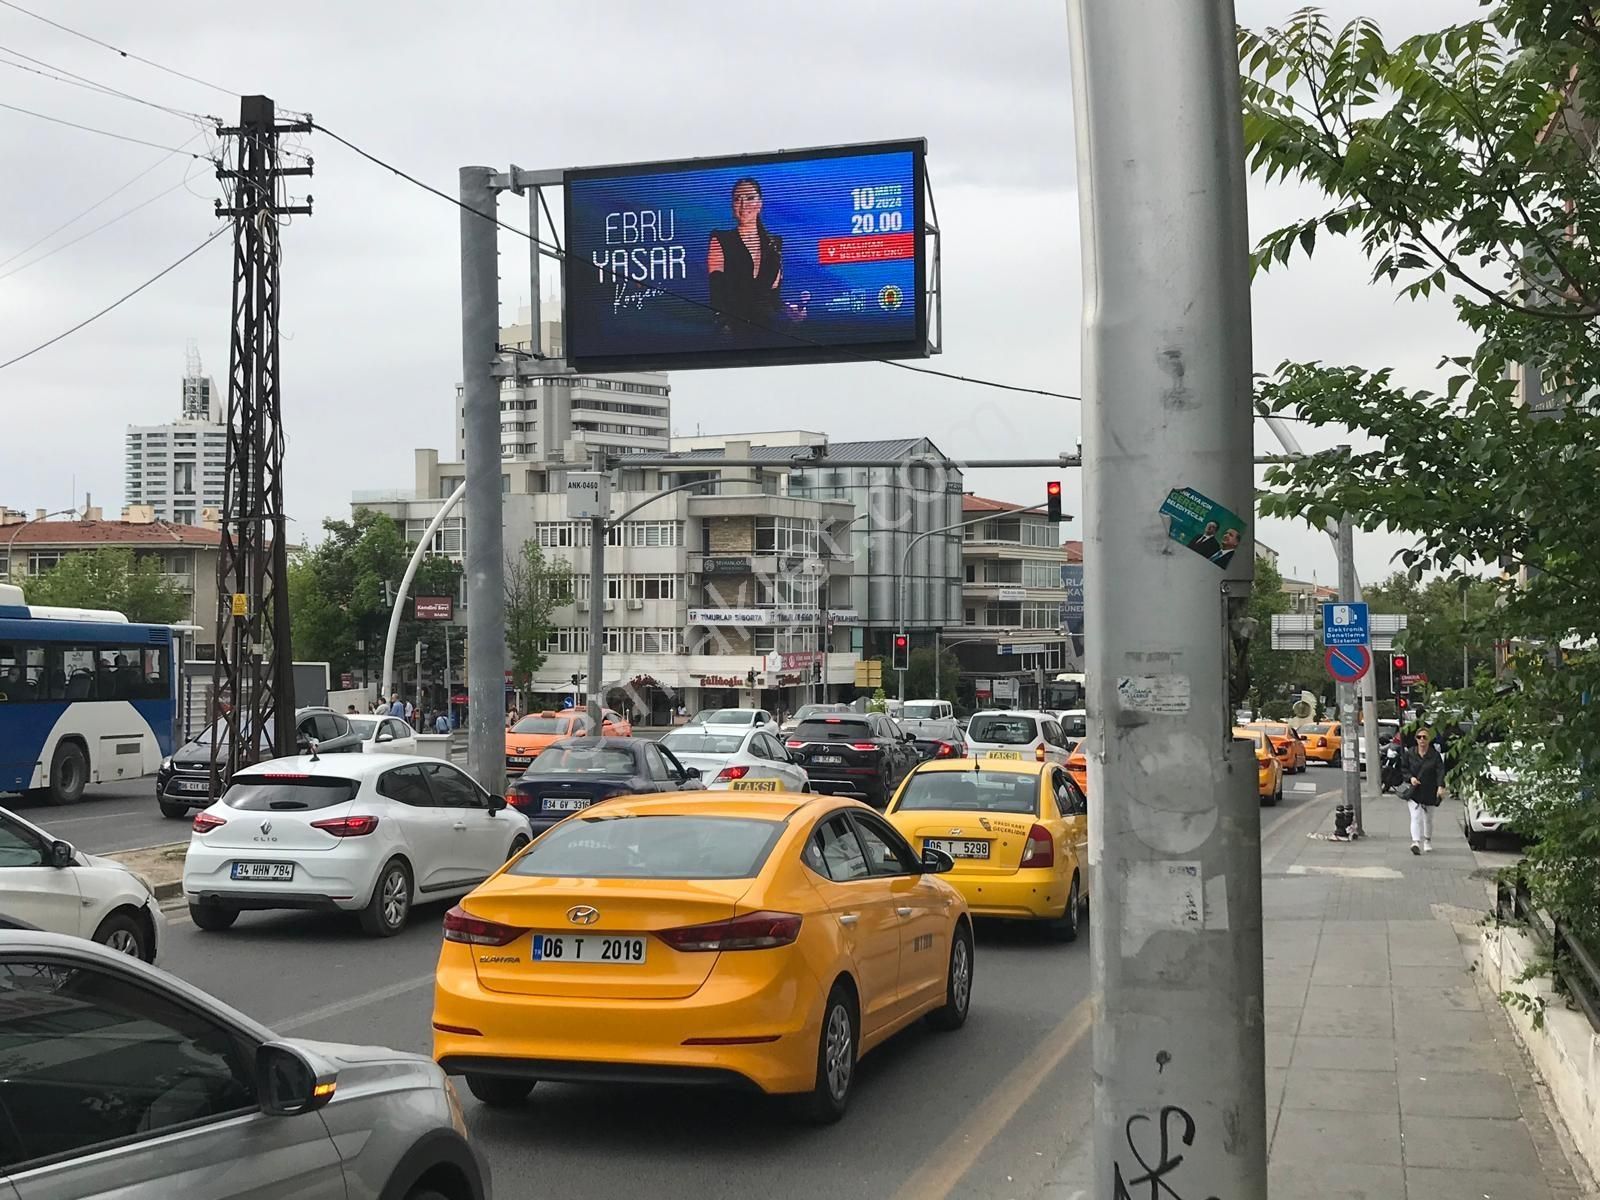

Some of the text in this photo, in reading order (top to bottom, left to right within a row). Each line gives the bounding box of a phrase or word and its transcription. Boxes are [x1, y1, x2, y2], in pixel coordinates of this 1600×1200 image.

[851, 187, 875, 210] 10
[875, 197, 902, 209] 2024
[606, 208, 674, 244] EBRU
[852, 211, 902, 233] 20.00
[547, 800, 556, 809] 34
[560, 800, 569, 809] GV
[948, 842, 954, 853] T
[964, 842, 988, 854] 5298
[238, 864, 290, 876] 34 HHN 784
[543, 938, 563, 958] 06
[575, 939, 584, 958] T
[601, 940, 643, 960] 2019
